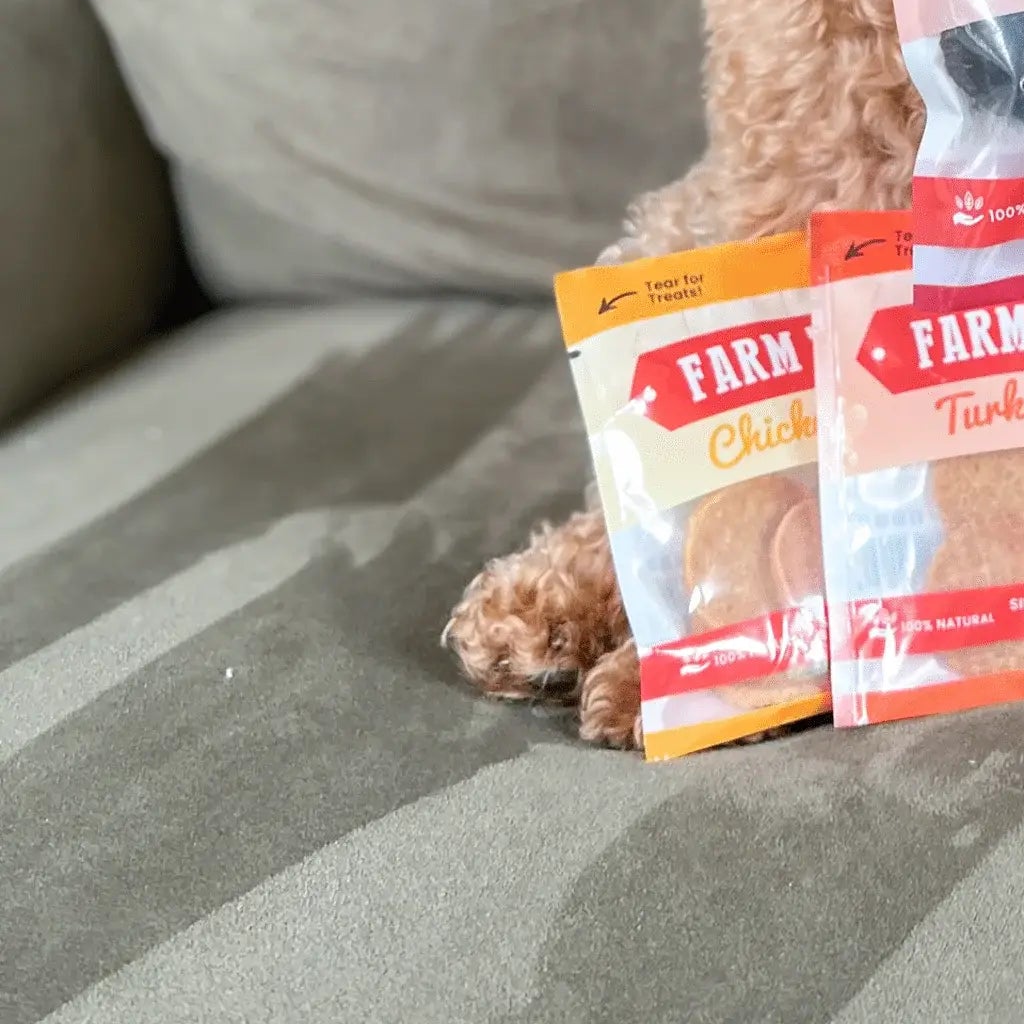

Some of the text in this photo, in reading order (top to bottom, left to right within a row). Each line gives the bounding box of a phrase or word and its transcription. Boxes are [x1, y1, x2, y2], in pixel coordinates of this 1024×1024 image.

[645, 274, 704, 292] Tear for
[649, 286, 703, 304] Treats!
[676, 331, 803, 404] FARM
[708, 399, 818, 470] Chick
[935, 612, 995, 632] NATURAL
